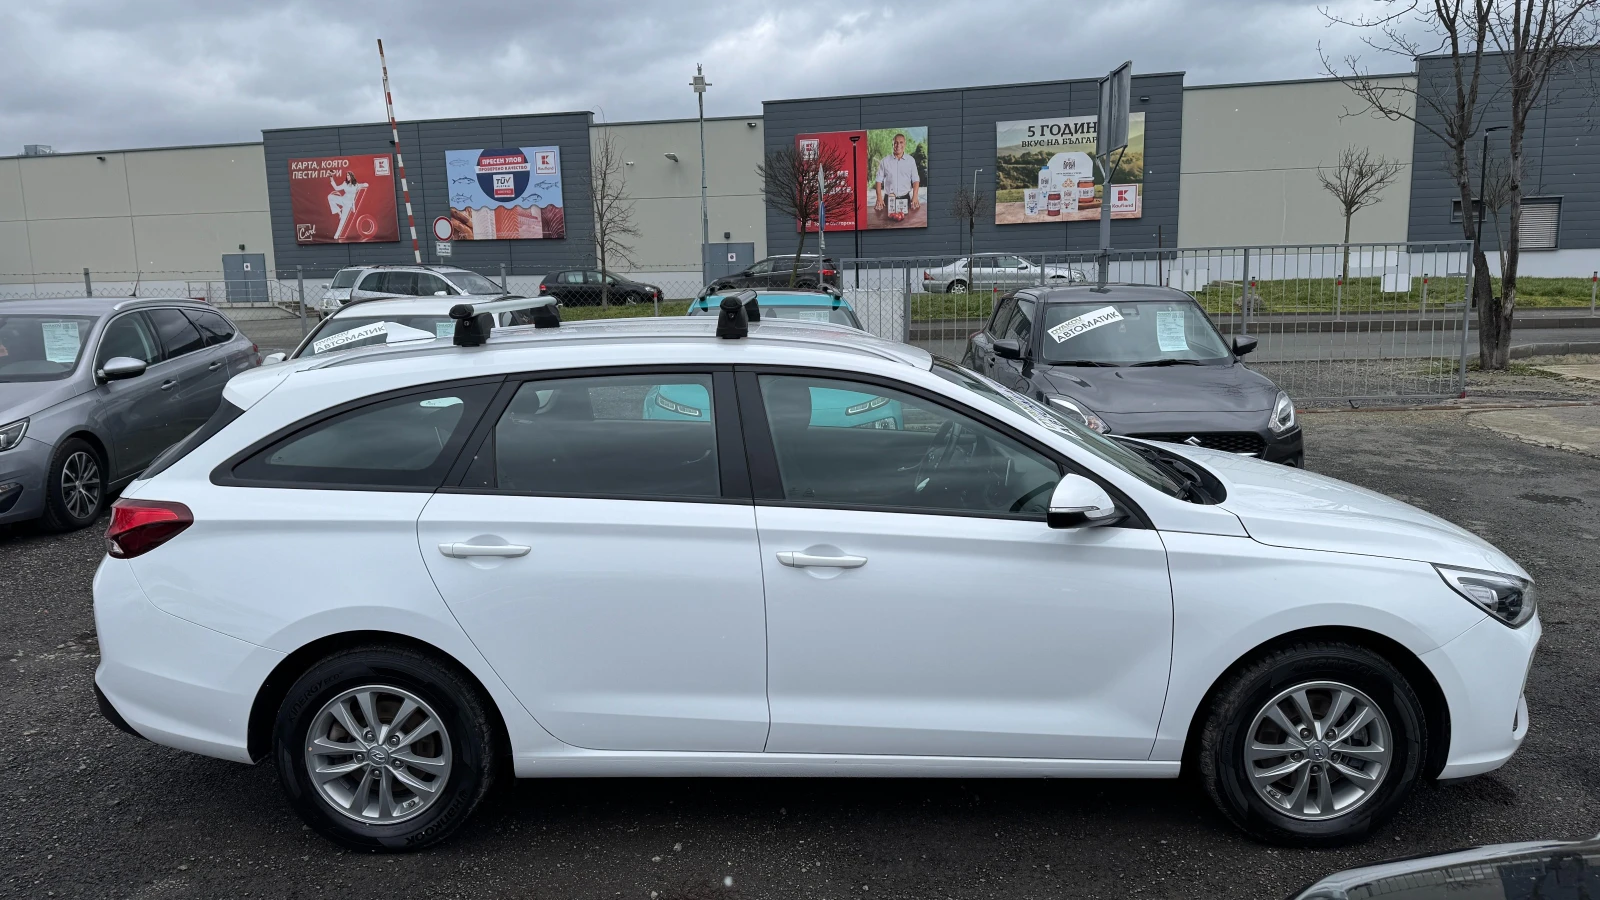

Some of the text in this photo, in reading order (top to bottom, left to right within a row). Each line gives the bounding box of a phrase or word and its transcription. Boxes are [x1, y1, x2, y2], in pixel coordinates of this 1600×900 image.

[1027, 121, 1098, 138] 5 ГОДИН
[1021, 139, 1045, 148] ВКУС
[1062, 137, 1097, 145] БЪЛГАР
[291, 160, 349, 170] КАРТА, КОЯТО
[292, 170, 318, 179] ПЕСТИ
[496, 177, 512, 185] TÜV
[300, 224, 316, 239] Card
[1057, 311, 1120, 342] АВТОМАТИК
[316, 326, 385, 353] АВТОМАТИК
